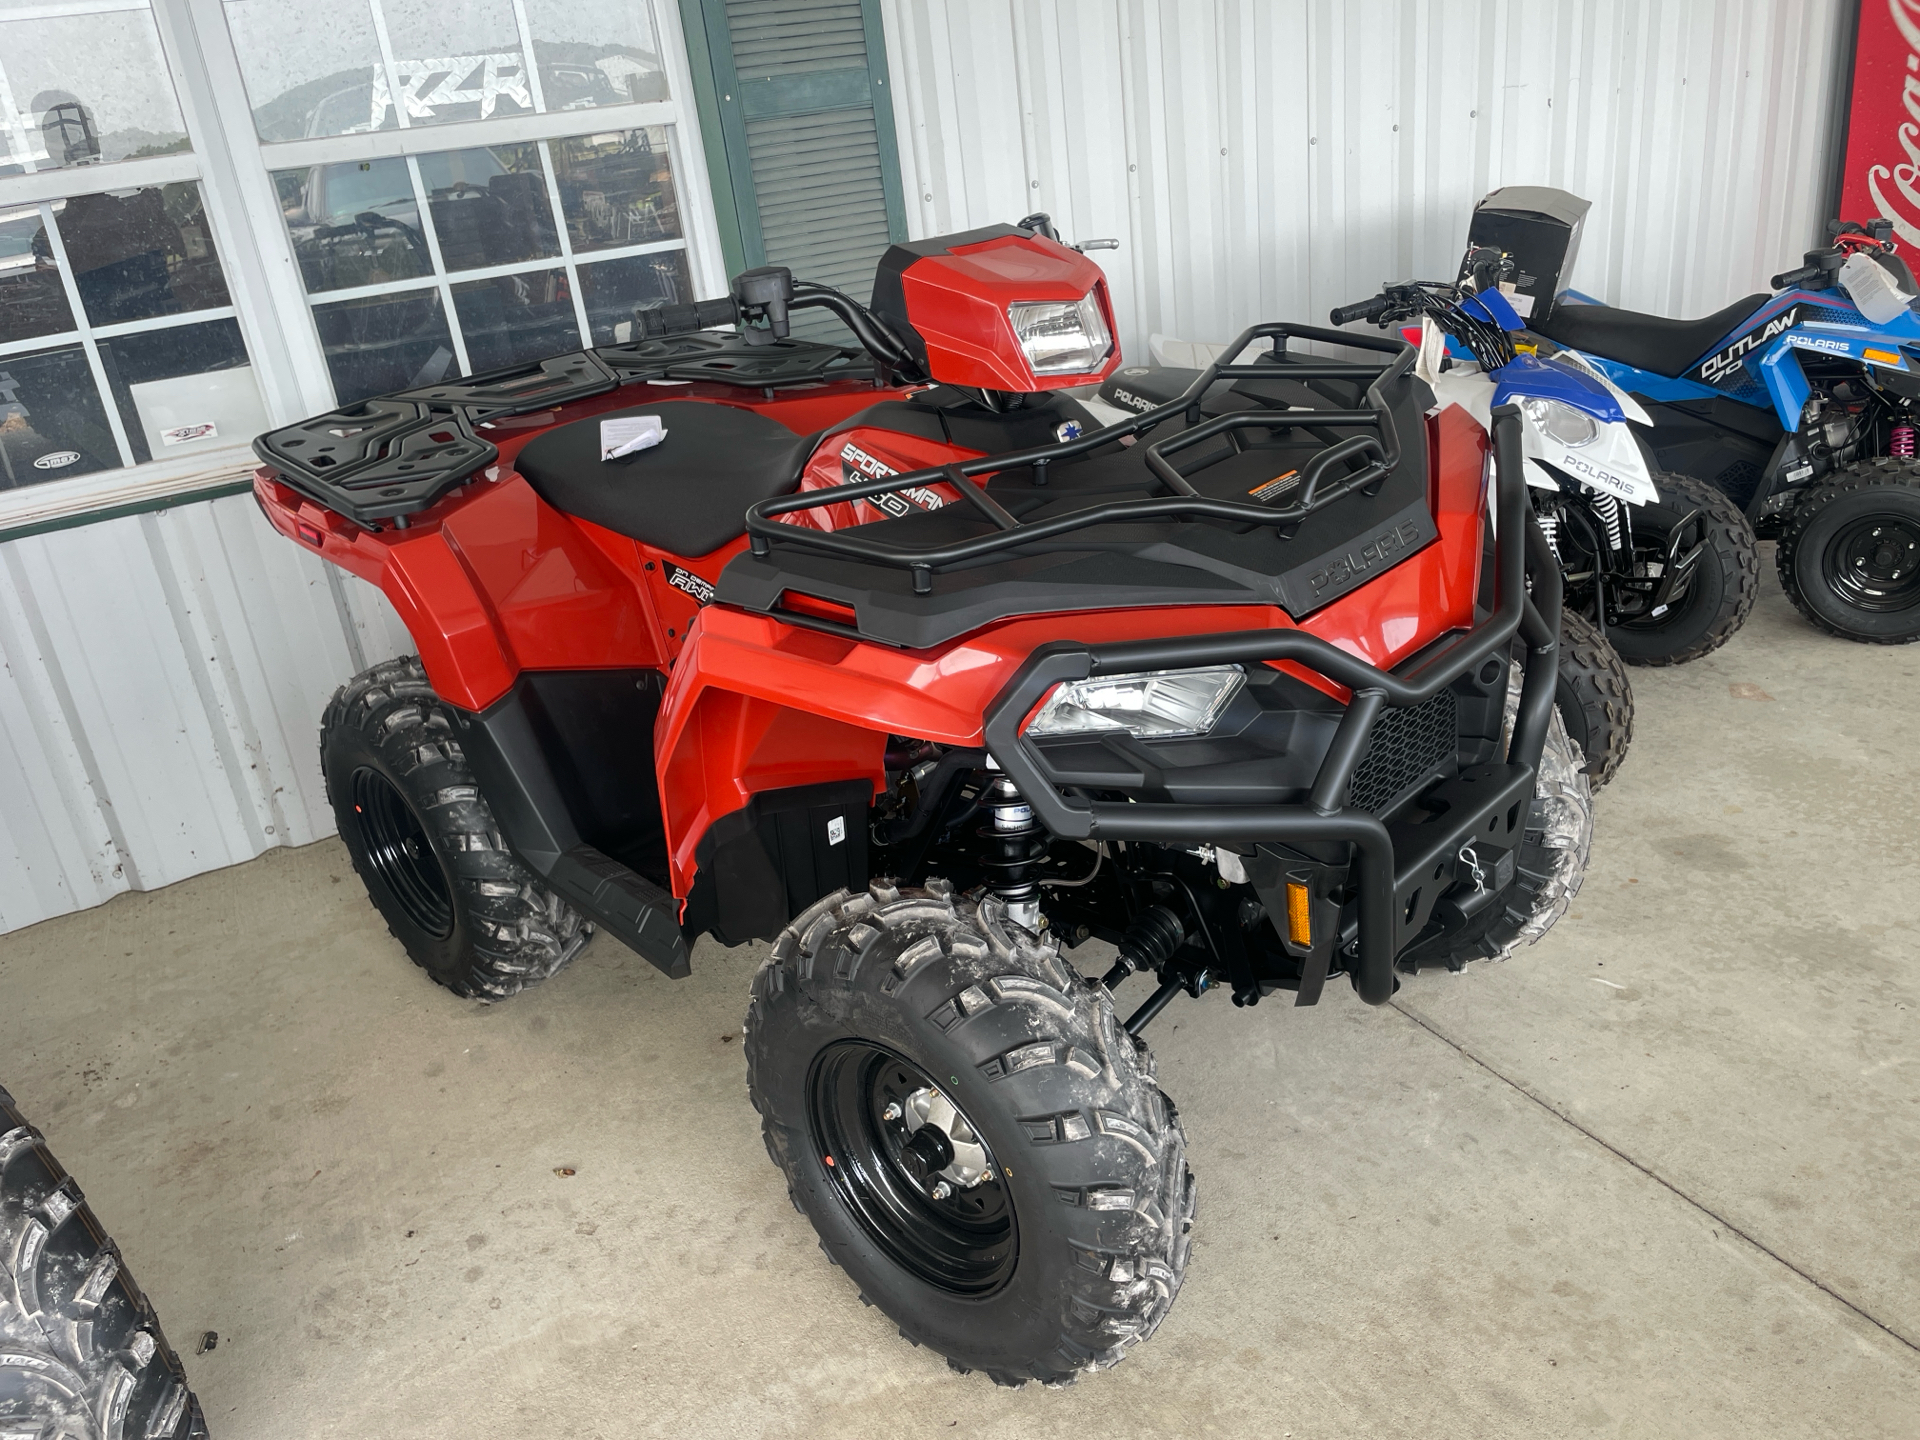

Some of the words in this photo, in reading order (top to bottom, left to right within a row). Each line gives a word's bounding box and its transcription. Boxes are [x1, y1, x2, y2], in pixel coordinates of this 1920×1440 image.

[371, 52, 532, 131] RZR
[1701, 307, 1798, 379] OUTLAW
[1786, 334, 1850, 351] POLARIS
[1709, 359, 1742, 384] 70
[1563, 455, 1635, 495] POLARIS
[1306, 519, 1419, 599] POLARIS
